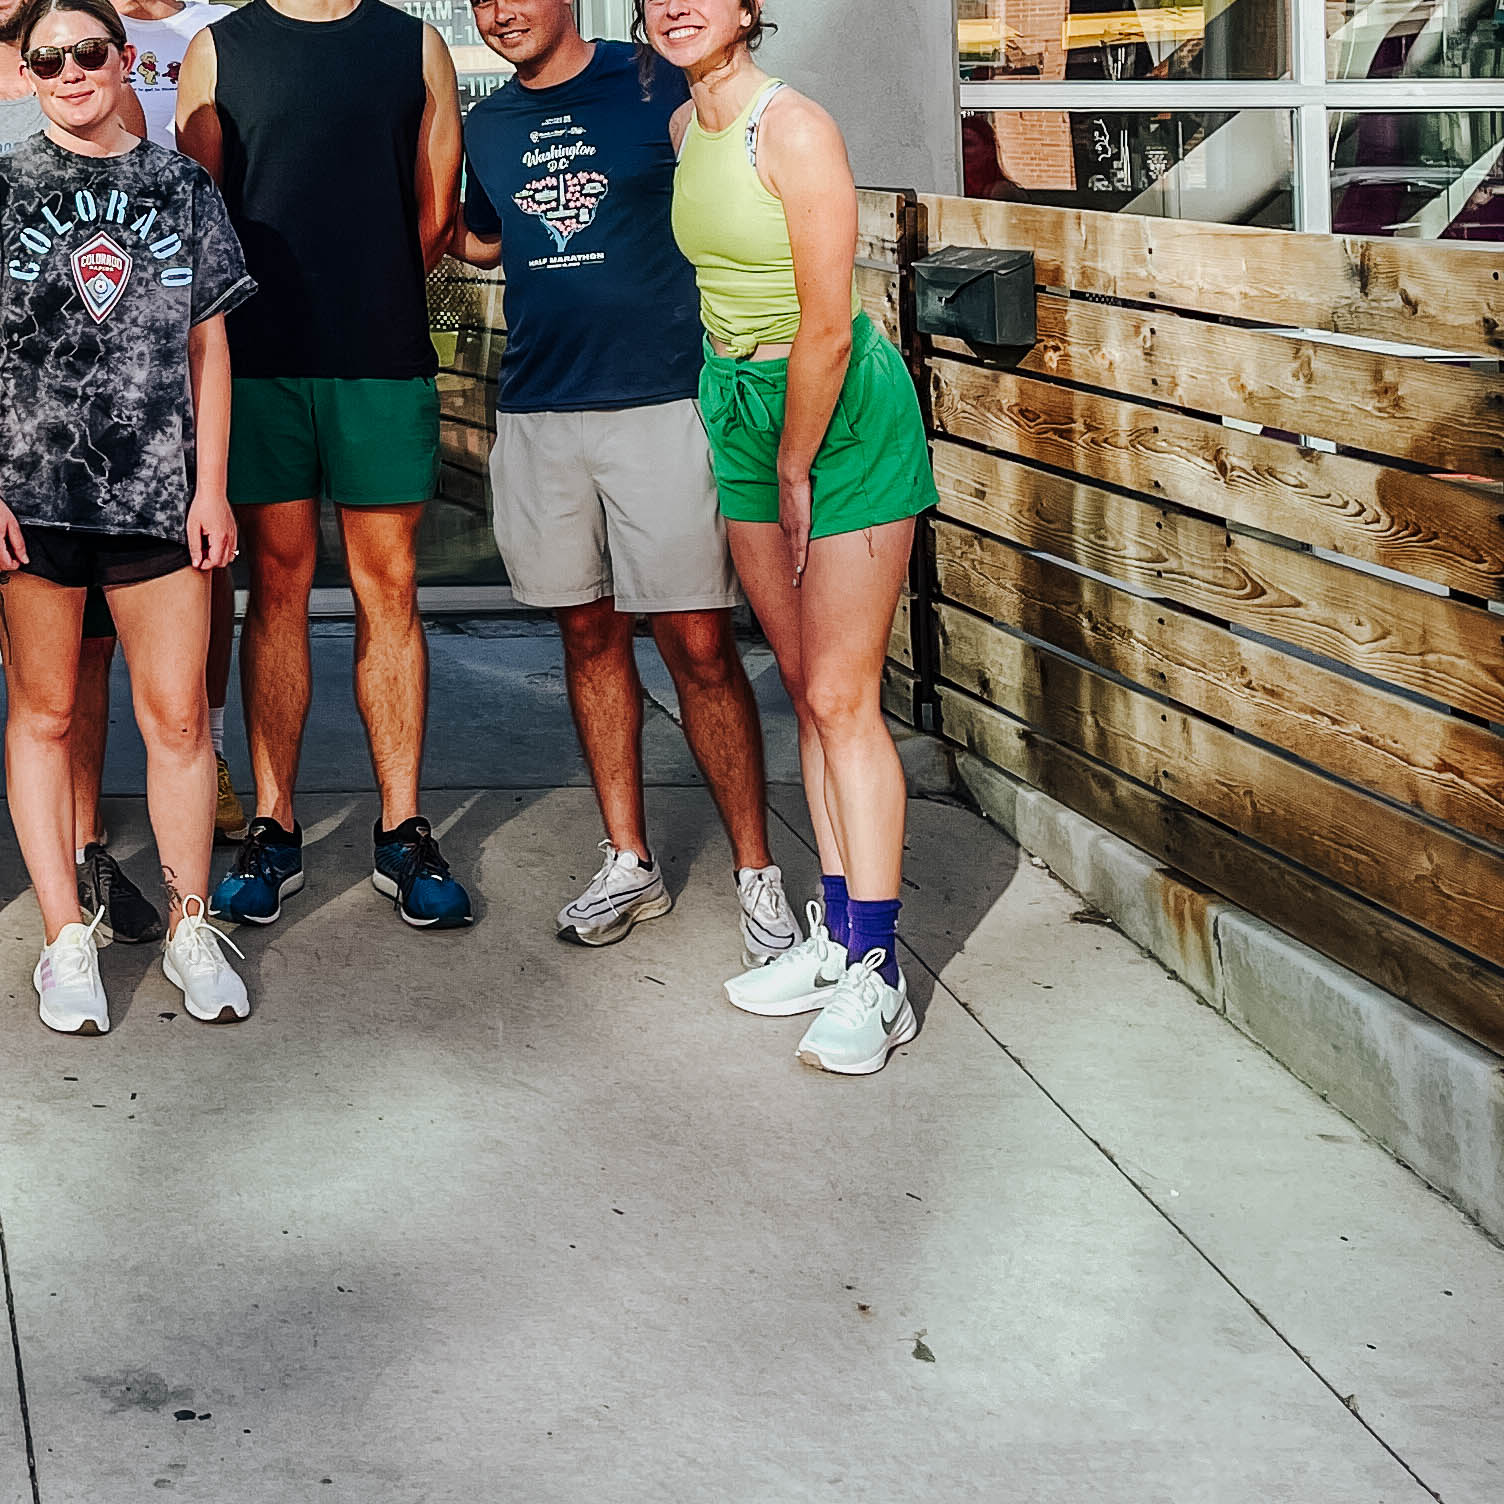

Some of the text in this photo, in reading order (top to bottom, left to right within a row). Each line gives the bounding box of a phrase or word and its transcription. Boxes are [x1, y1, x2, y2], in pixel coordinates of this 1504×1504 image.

[522, 140, 597, 168] Washington
[8, 189, 194, 288] COLORADO
[80, 252, 123, 271] COLORADO
[549, 252, 605, 264] MARATHON
